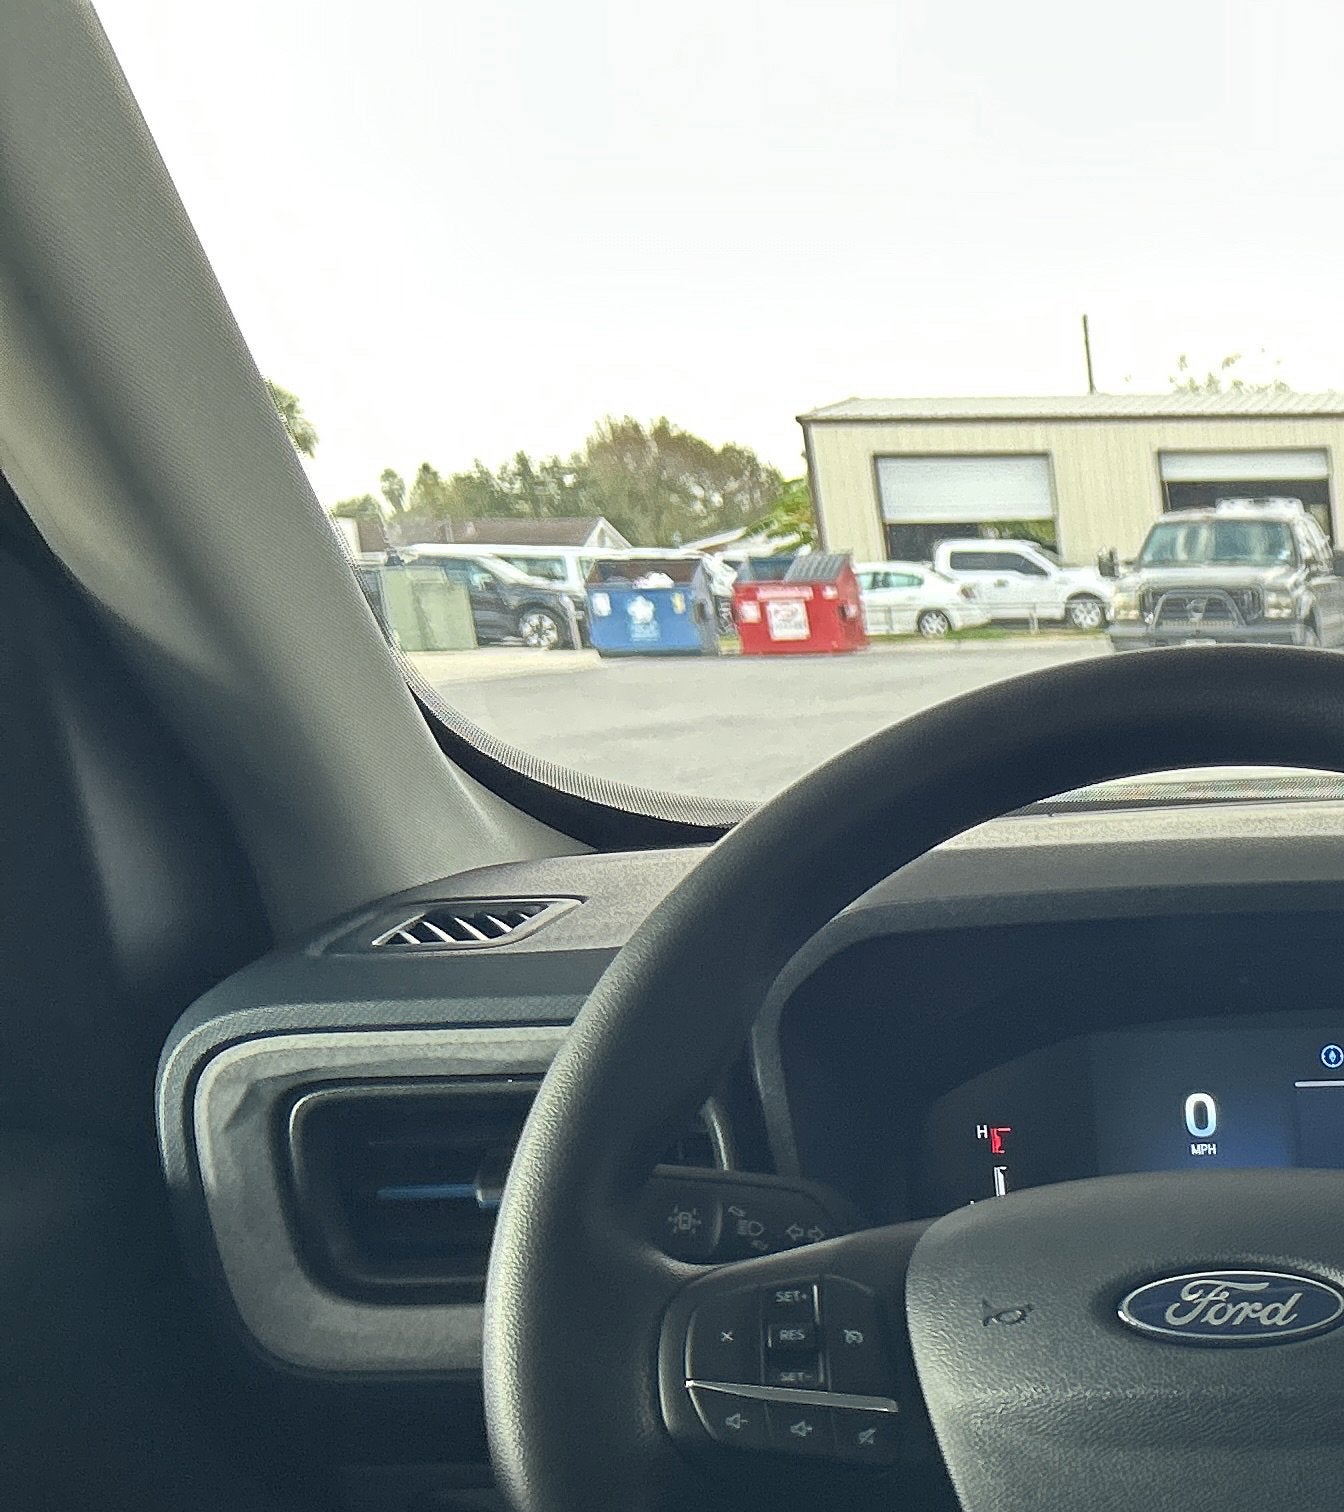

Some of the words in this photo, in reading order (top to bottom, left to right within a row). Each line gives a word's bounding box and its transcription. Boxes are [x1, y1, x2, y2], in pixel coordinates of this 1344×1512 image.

[1184, 1092, 1217, 1138] 0
[976, 1124, 988, 1139] H
[1190, 1143, 1217, 1155] MPH
[1165, 1279, 1303, 1326] Ford
[780, 1329, 806, 1341] RES
